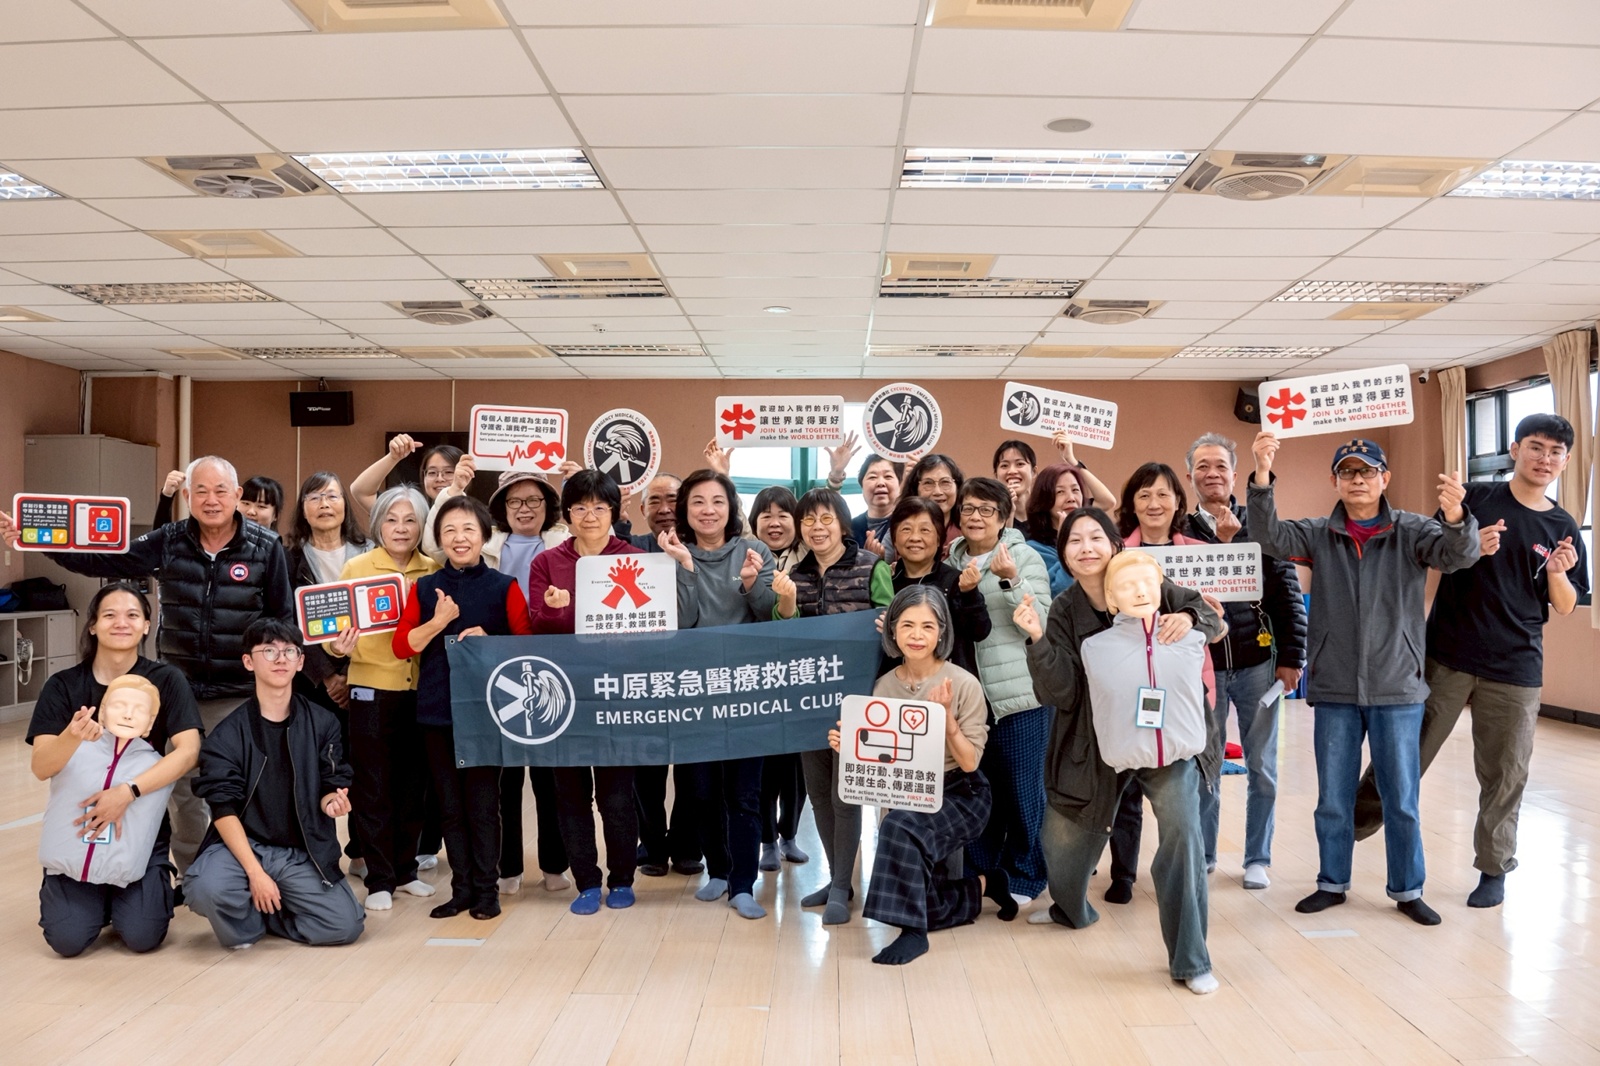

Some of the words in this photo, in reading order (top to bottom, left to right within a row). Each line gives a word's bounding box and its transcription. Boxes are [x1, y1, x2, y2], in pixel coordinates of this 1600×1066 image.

[1310, 375, 1403, 394] 歡迎加入我們的行列
[1311, 388, 1405, 408] 讓世界變得更好
[1044, 397, 1113, 417] 歡迎加入我們的行列
[1312, 410, 1330, 418] JOIN
[1366, 401, 1406, 411] TOGETHER
[481, 414, 557, 426] 每個人都能成為生命的
[760, 416, 839, 425] 讓世界變得更好
[1043, 407, 1112, 429] 讓世界變得更好
[1349, 413, 1377, 421] WORLD
[1379, 409, 1409, 417] BETTER.
[1067, 430, 1088, 438] WORLD
[1081, 426, 1111, 436] TOGETHER
[1165, 553, 1255, 564] 歡迎加入我們的行列
[1165, 565, 1256, 578] 讓世界變得更好
[585, 611, 666, 622] 危急時刻、伸出援手
[586, 620, 667, 630] 一技在手、救護你我
[593, 654, 845, 700] 中原緊急醫療救護社
[596, 706, 705, 725] EMERGENCY
[712, 698, 793, 720] MEDICAL
[800, 692, 844, 711] CLUB
[845, 763, 936, 783] 即刻行動、學習急救
[845, 775, 936, 795] 守護生命、傳遞溫暖
